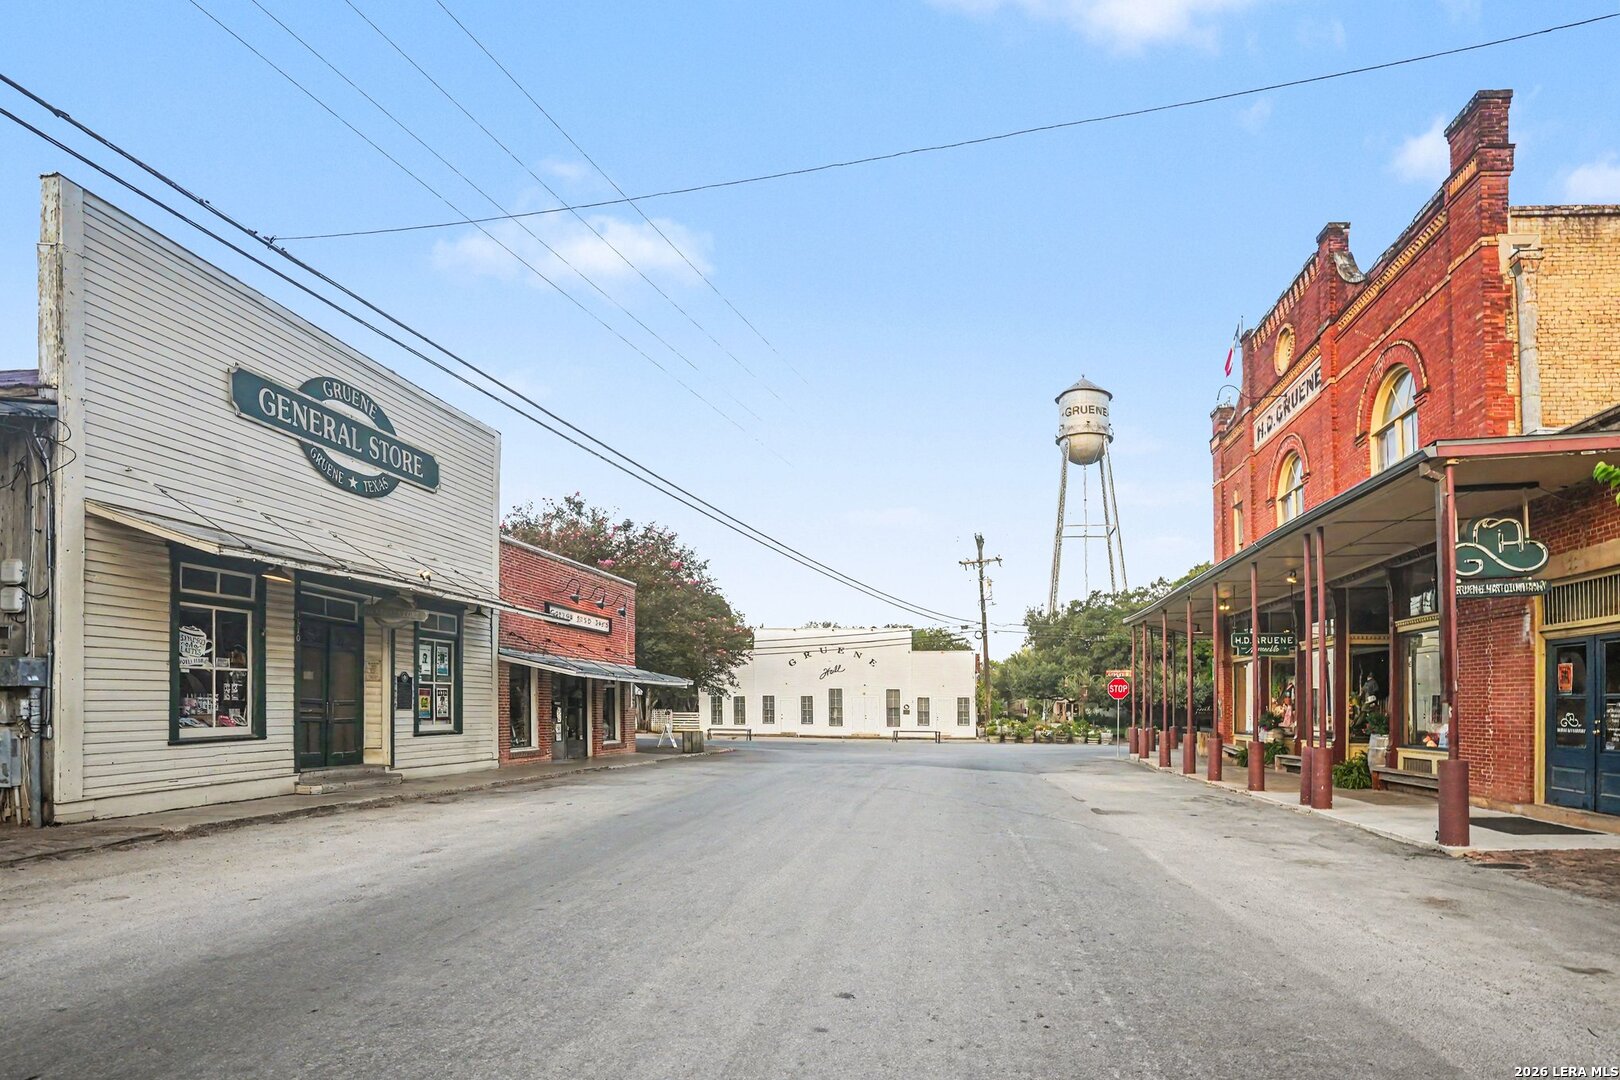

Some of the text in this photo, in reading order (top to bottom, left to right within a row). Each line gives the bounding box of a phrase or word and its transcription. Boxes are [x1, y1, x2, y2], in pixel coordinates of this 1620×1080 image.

[323, 380, 378, 420] GRUENE
[1276, 366, 1321, 423] GRUENE
[1065, 405, 1108, 417] GRUENE
[258, 387, 424, 479] GENERAL STORE
[310, 447, 389, 493] GRUENE TEXAS
[1455, 583, 1485, 595] RUENE
[1235, 636, 1252, 645] H.D.
[788, 647, 877, 667] GRUENE
[819, 665, 846, 680] Hall
[1109, 684, 1128, 693] STOP
